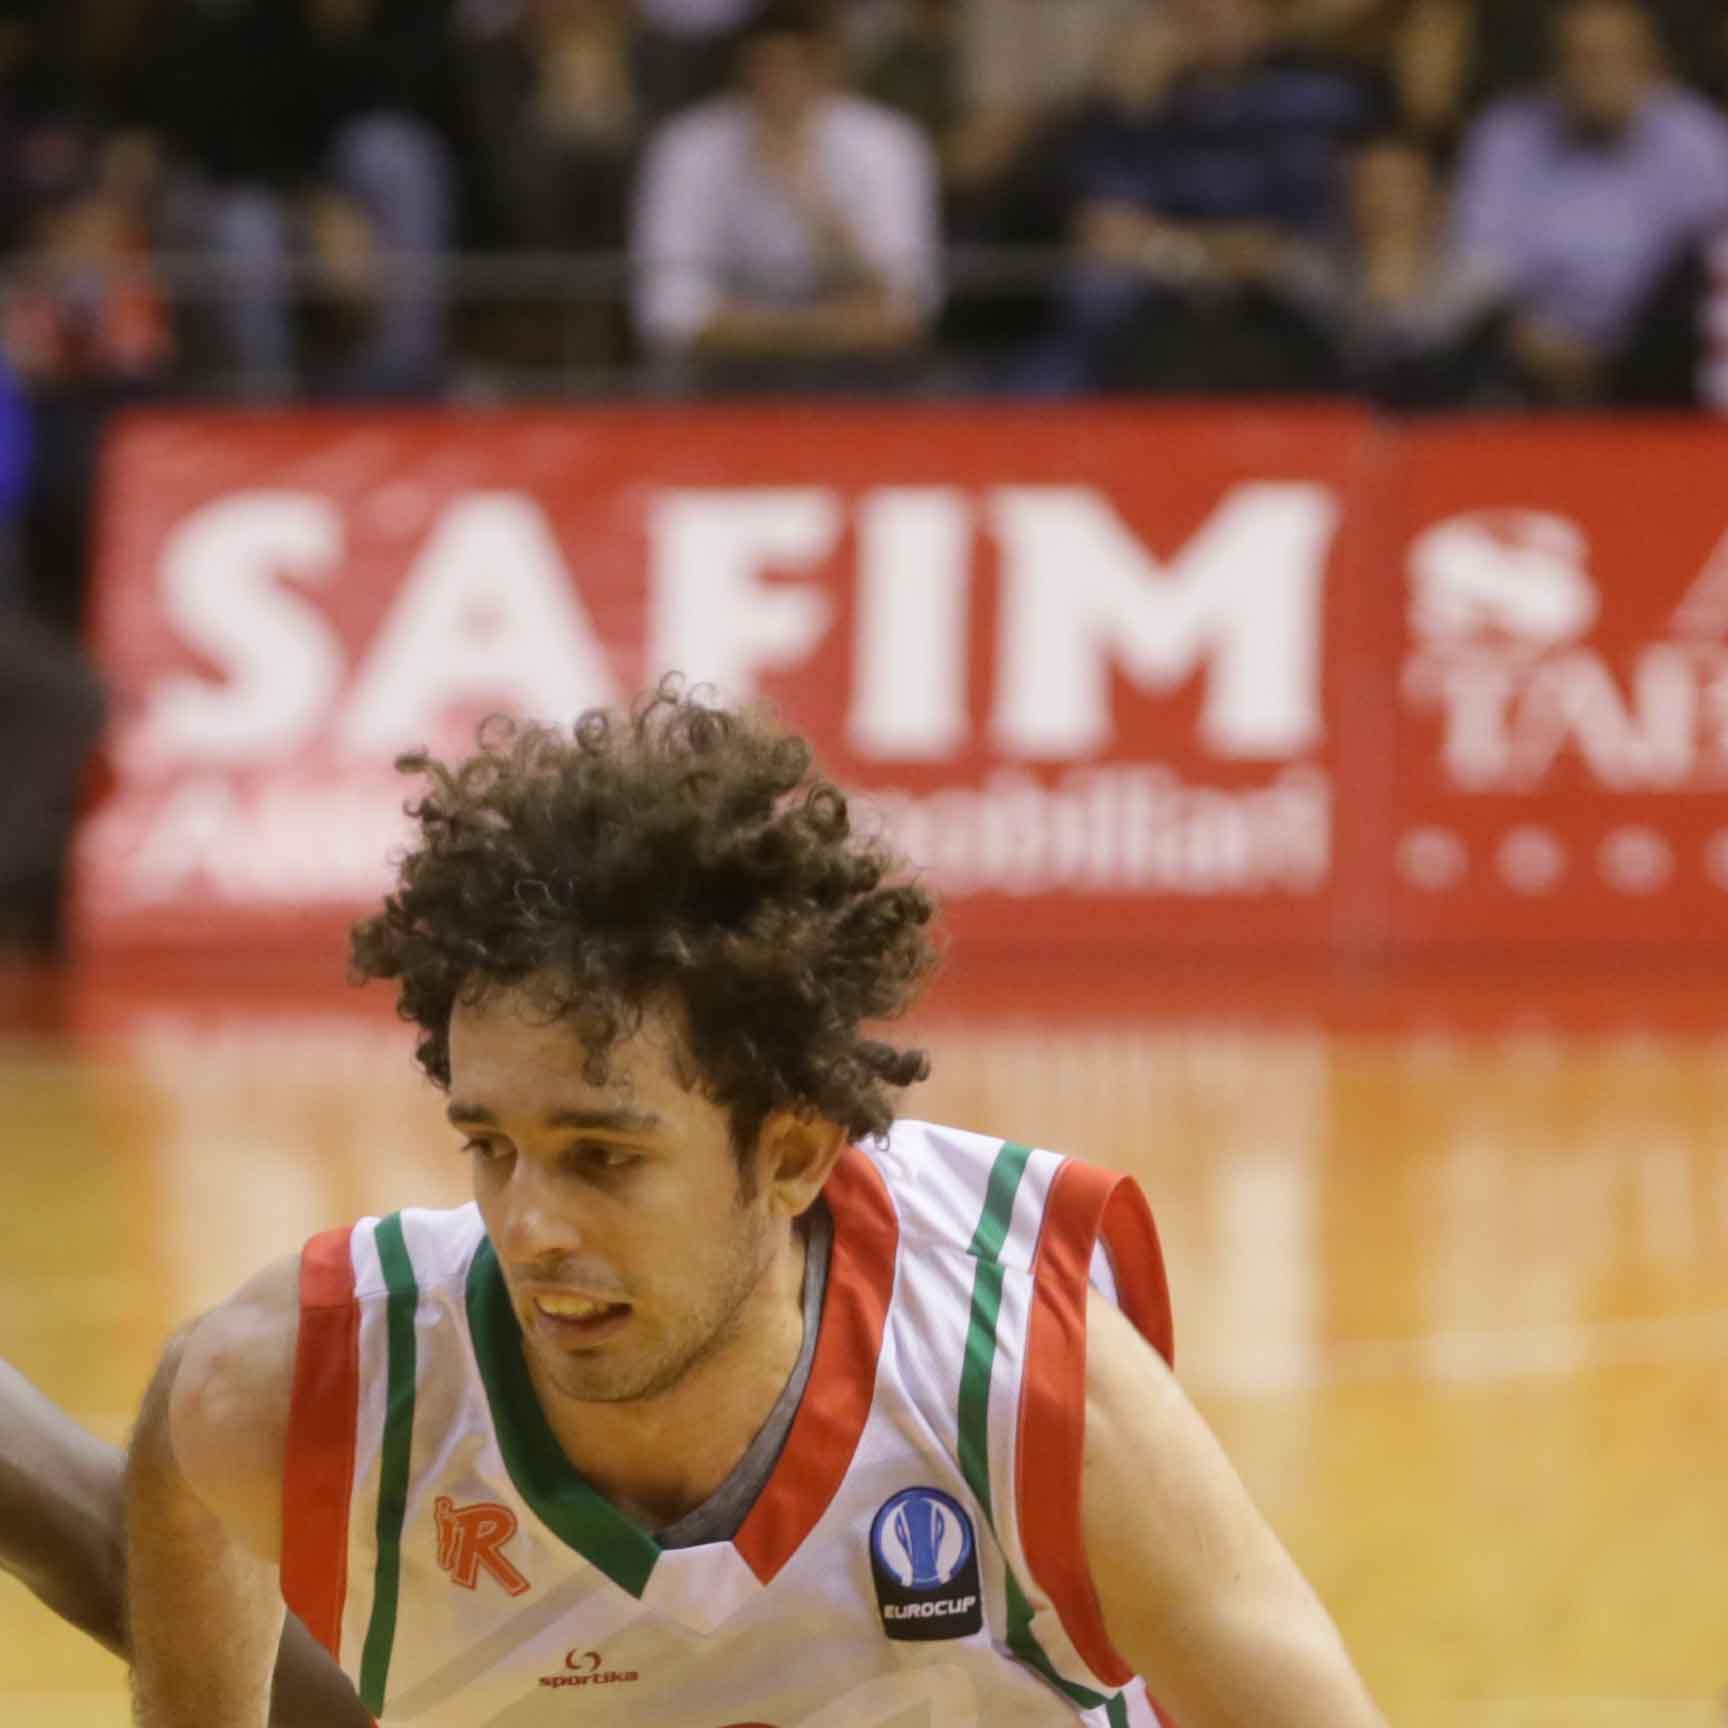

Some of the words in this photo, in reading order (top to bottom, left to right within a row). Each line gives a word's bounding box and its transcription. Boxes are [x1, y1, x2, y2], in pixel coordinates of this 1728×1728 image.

[142, 480, 1340, 764] SAFIM
[883, 1594, 977, 1620] EUROCUP
[537, 1670, 641, 1689] sportika
